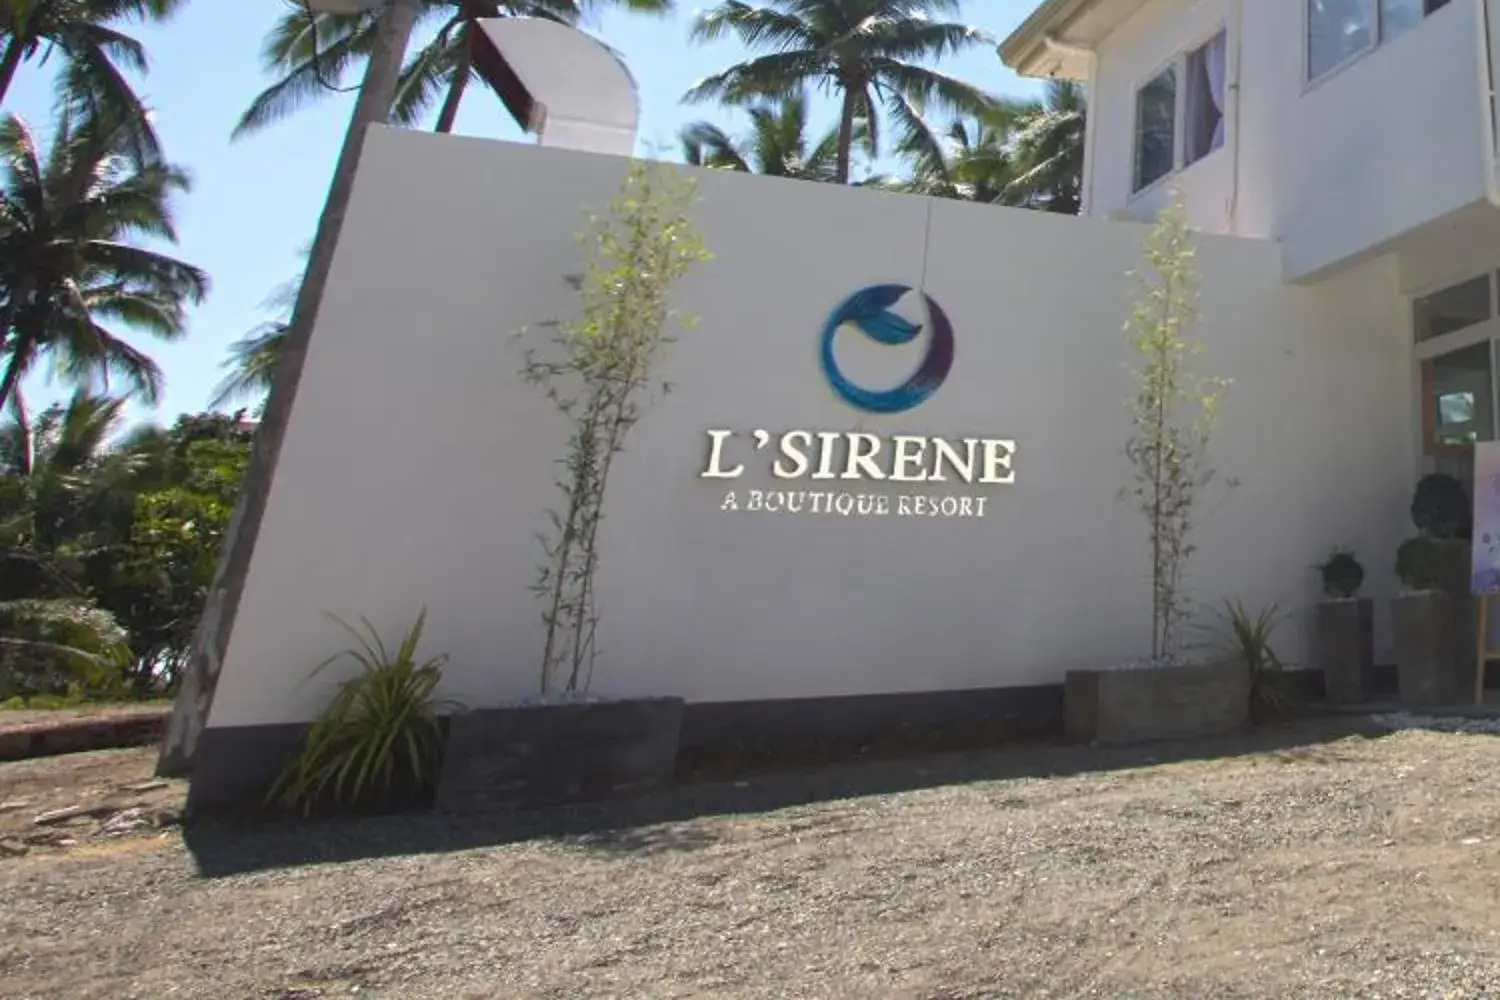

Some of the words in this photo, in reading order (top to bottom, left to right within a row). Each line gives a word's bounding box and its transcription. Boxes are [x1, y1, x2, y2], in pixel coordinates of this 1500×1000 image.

[701, 428, 1017, 485] L'SIRENE
[720, 489, 739, 512] A
[747, 489, 889, 517] BOUTIQUE
[897, 494, 988, 518] RESORT
